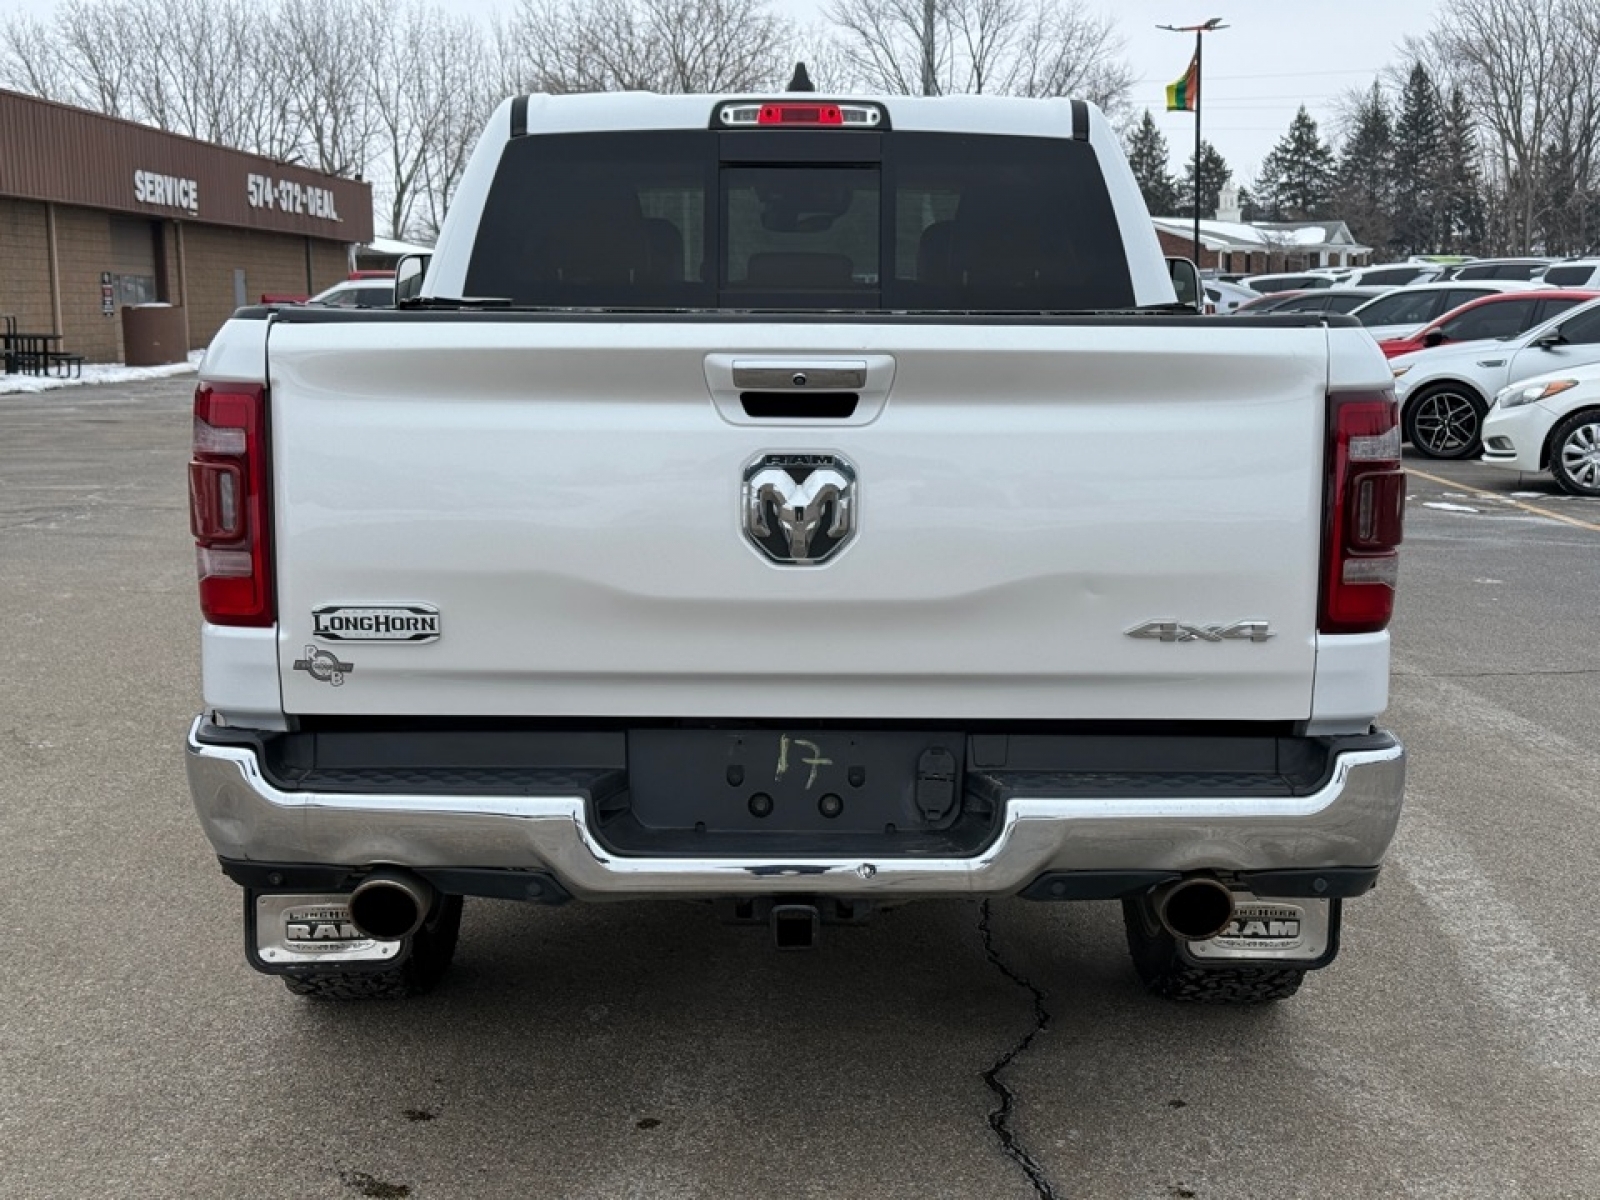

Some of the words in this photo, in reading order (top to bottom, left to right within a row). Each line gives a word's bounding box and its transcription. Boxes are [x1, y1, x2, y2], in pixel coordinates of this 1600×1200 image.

[135, 170, 198, 210] SERVICE
[248, 173, 337, 219] 574-372-DEAL
[765, 454, 835, 466] RAM
[313, 614, 436, 633] LONGHORN
[775, 733, 832, 790] 17
